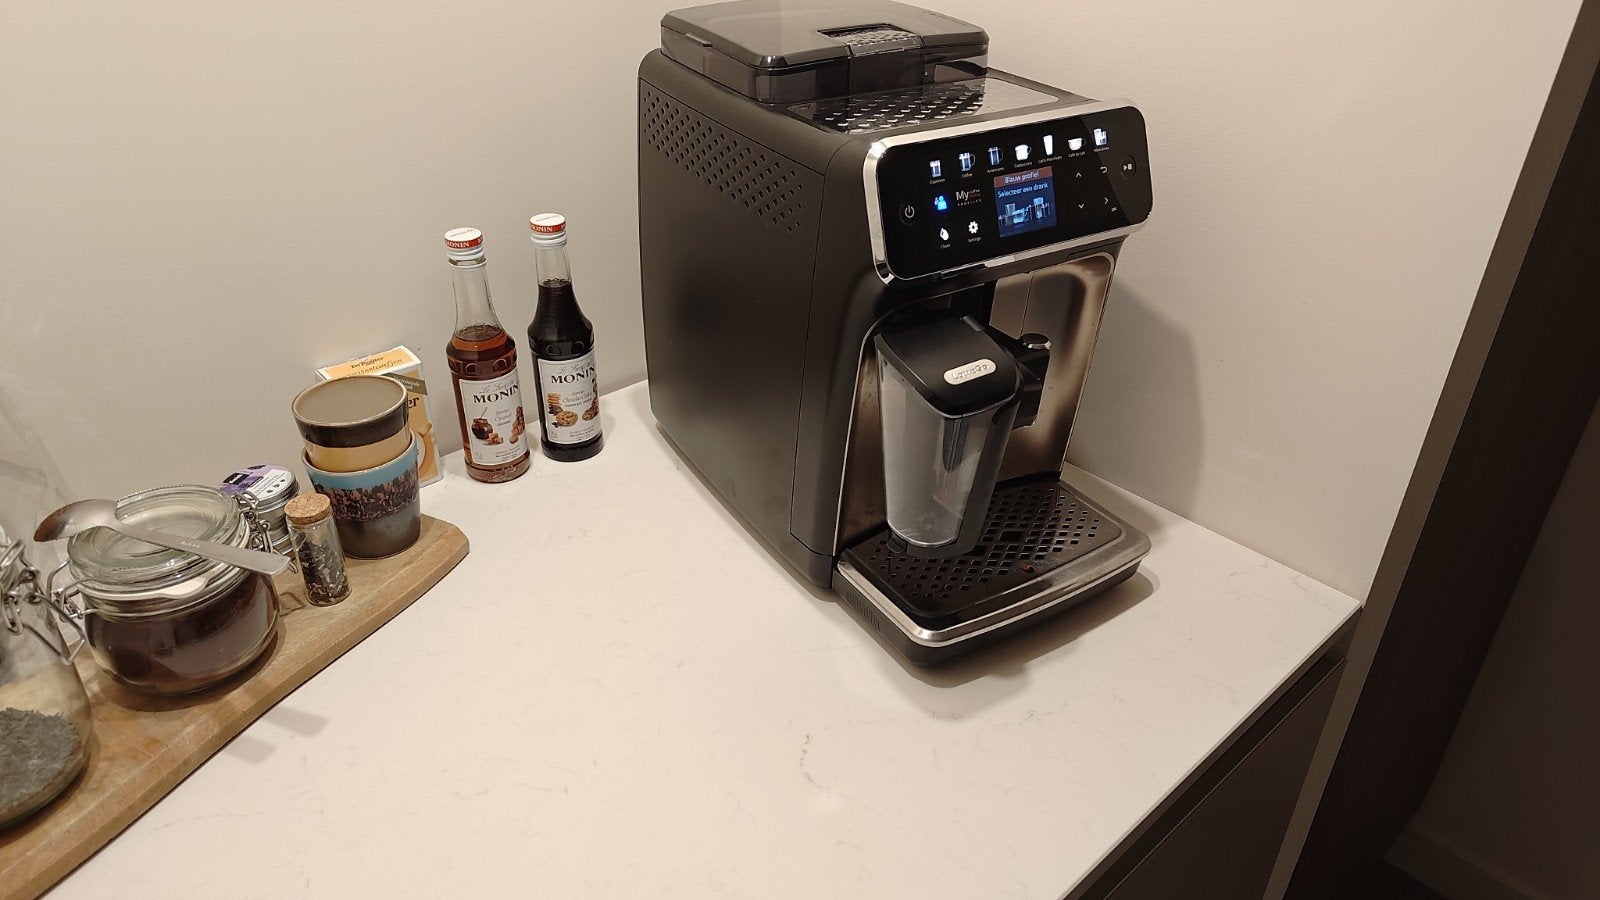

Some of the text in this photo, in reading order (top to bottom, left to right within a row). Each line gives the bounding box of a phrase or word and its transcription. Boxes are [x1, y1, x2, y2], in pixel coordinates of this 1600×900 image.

[1004, 170, 1039, 184] Blauw profiel
[955, 190, 969, 201] My
[997, 181, 1049, 198] Selecteer een drank
[551, 366, 595, 384] MONIN
[473, 384, 519, 403] MONIN
